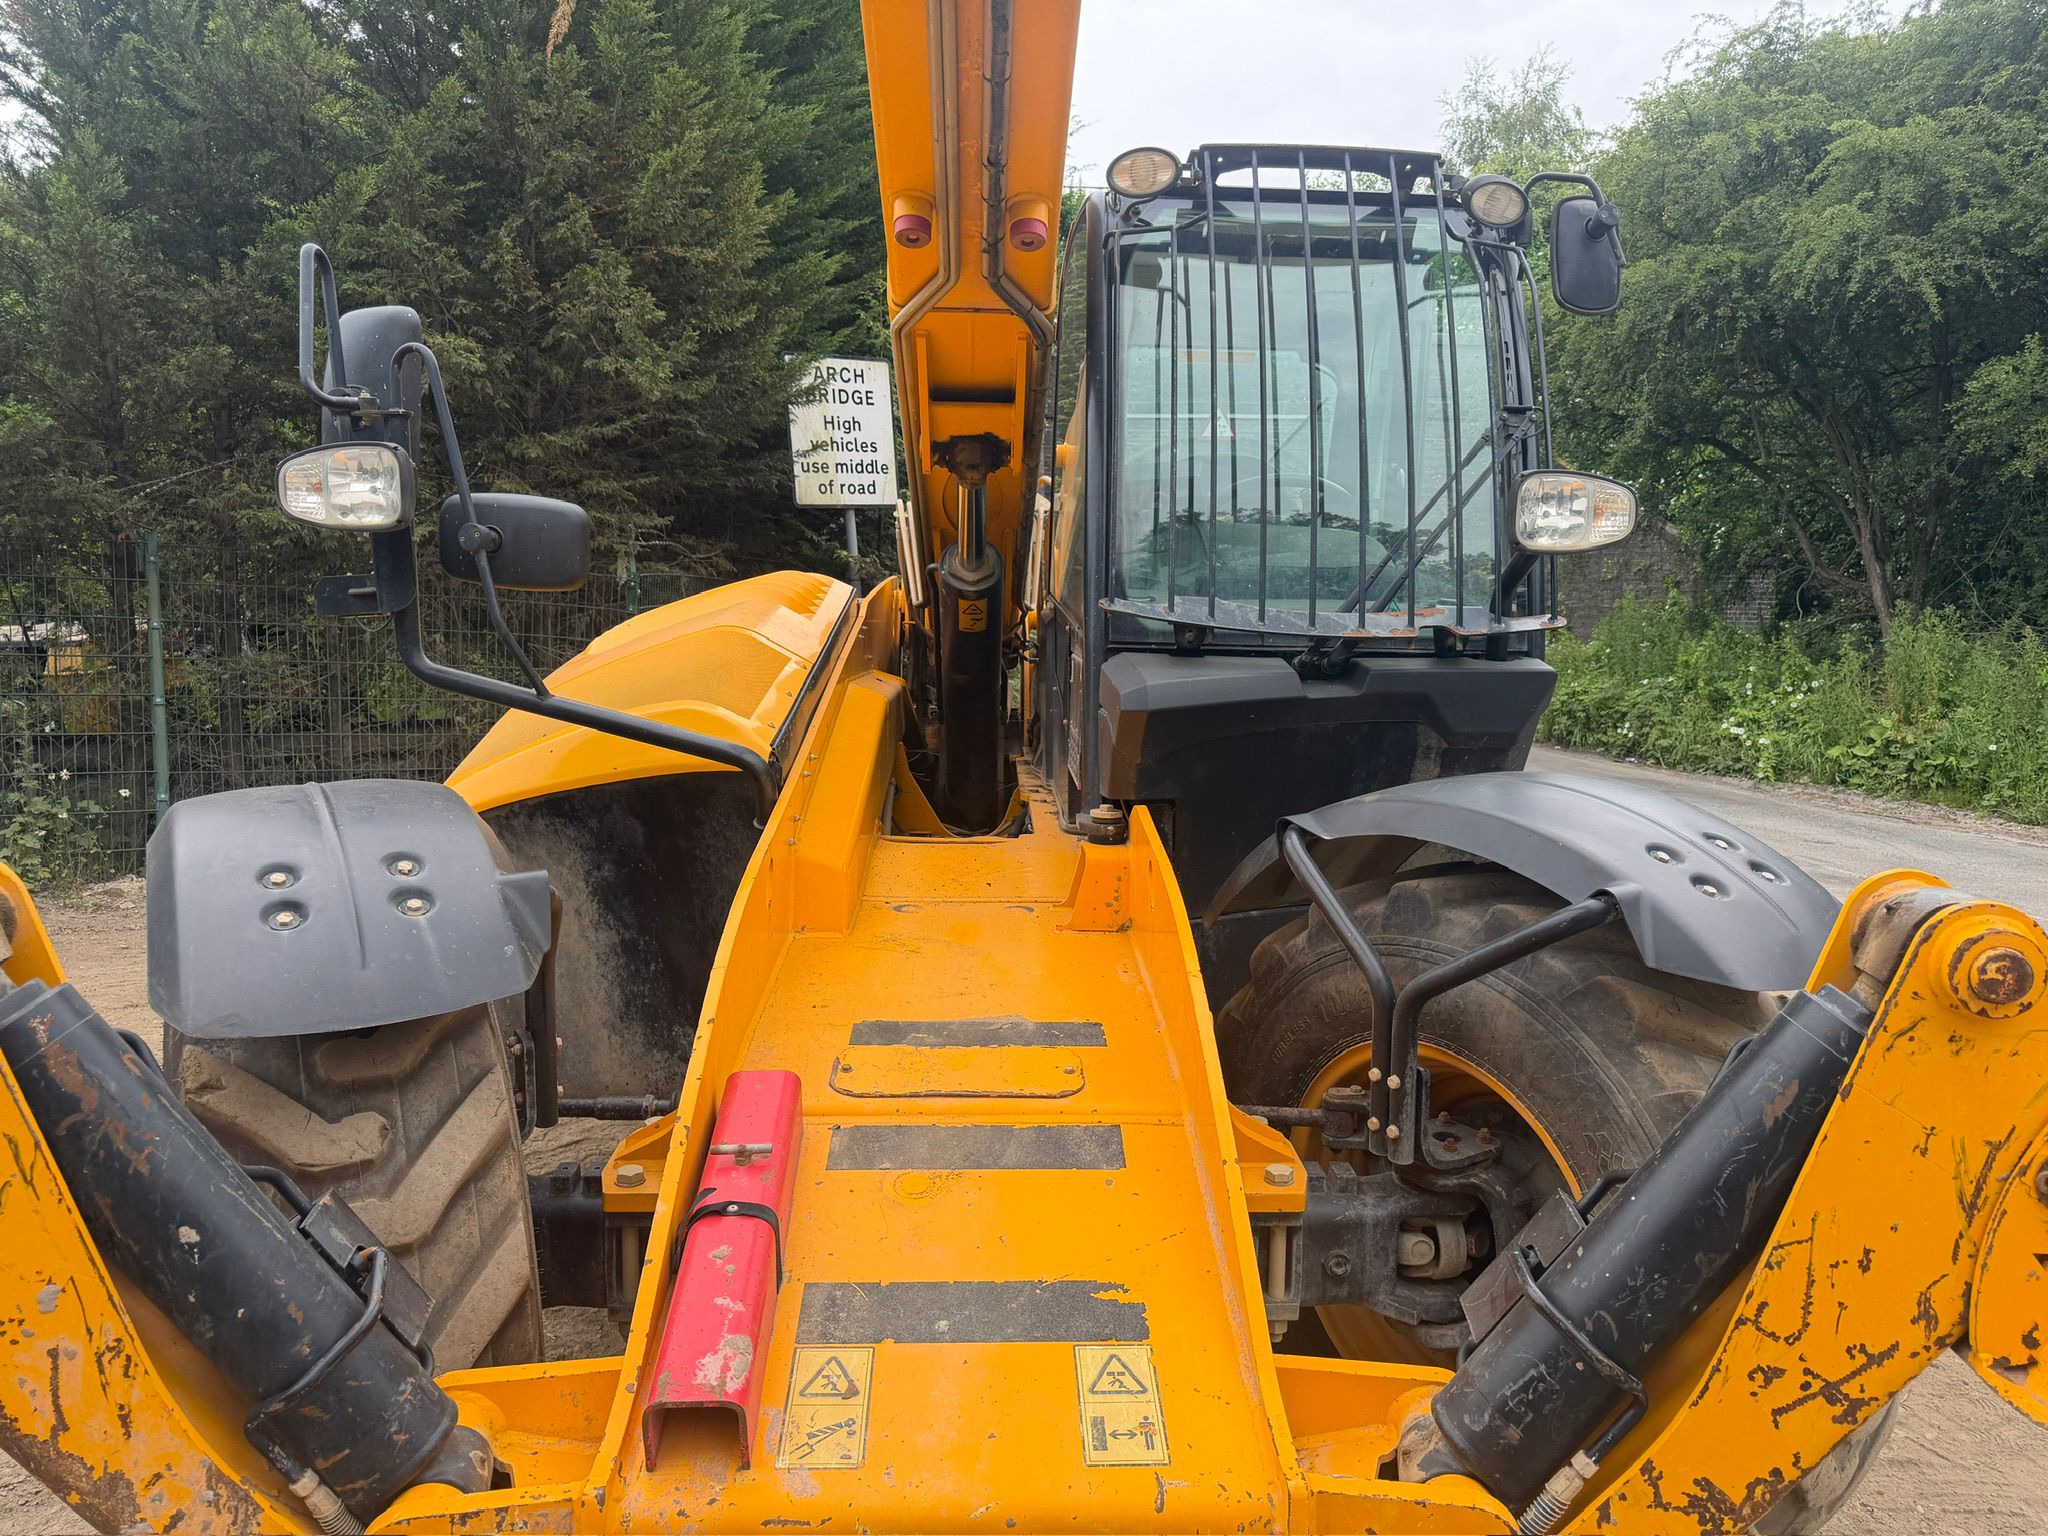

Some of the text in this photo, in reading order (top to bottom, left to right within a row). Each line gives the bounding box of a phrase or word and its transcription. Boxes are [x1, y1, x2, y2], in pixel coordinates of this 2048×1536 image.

[813, 366, 865, 384] ARCH
[815, 389, 875, 406] RIDGE
[824, 415, 862, 434] High
[810, 437, 878, 453] vehicles
[801, 459, 889, 475] use middle
[818, 480, 877, 495] of road
